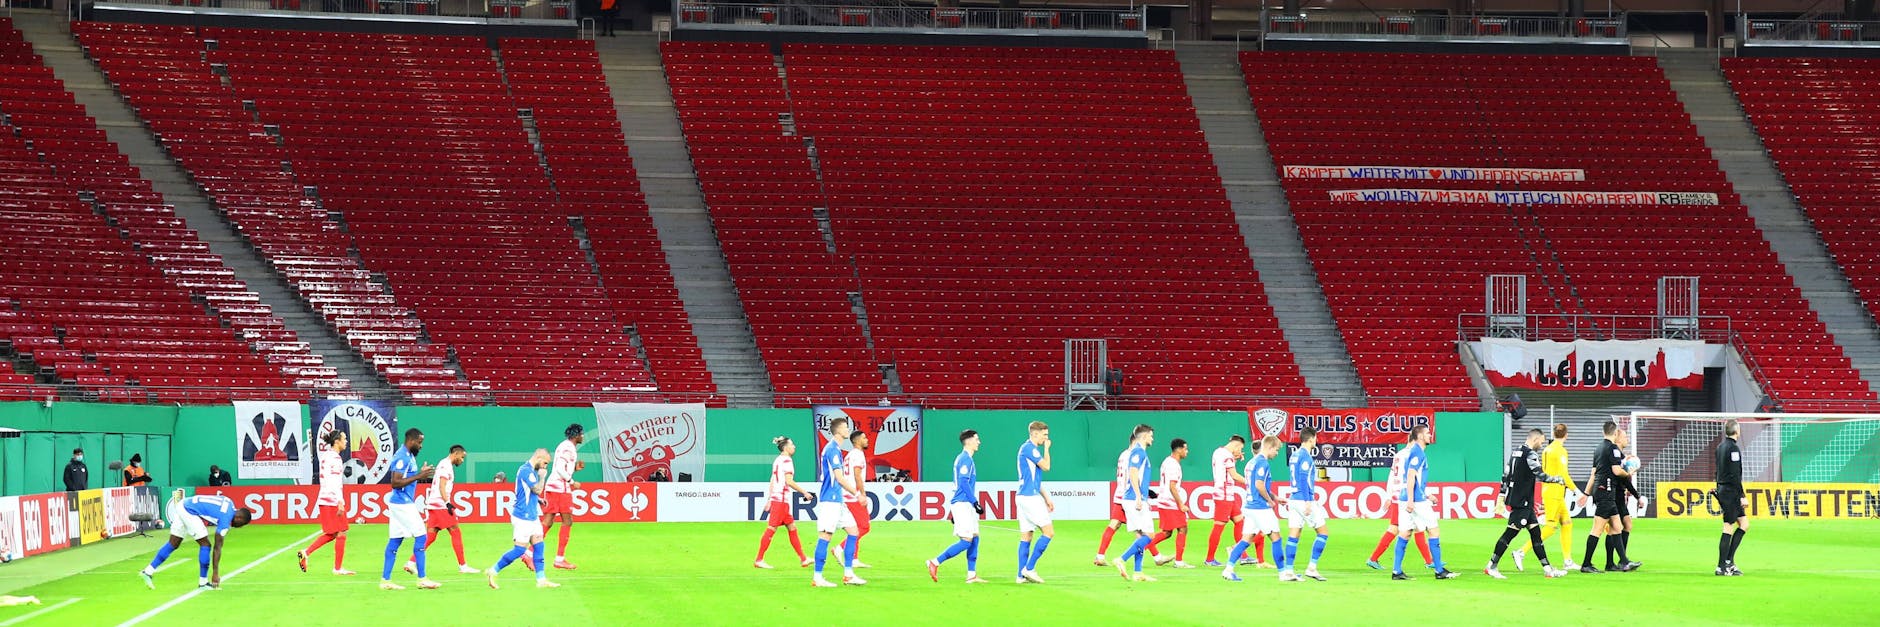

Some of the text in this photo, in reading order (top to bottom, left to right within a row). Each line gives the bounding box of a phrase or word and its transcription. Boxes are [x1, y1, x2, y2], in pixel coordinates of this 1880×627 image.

[1286, 167, 1577, 182] KÄMPFT WEITER MIT UND LEIDENSCHAFT
[1331, 191, 1359, 202] WIR
[1361, 190, 1419, 203] WOLLEN
[1420, 190, 1450, 203] ZUM
[1464, 191, 1489, 203] MAL
[1495, 192, 1519, 204] MIT
[1523, 192, 1561, 205] EUCH
[1564, 193, 1604, 205] NACH
[1606, 193, 1656, 205] BERLIN
[1658, 193, 1680, 205] RB
[1537, 358, 1648, 387] L.E. BULLS
[318, 420, 334, 452] RED
[346, 405, 391, 453] CAMPUS
[867, 416, 920, 433] Bulls
[1293, 415, 1430, 433] BULLS CLUB
[1331, 459, 1351, 467] FROM
[452, 490, 611, 517] STRSS
[1424, 485, 1508, 519] ERG
[1666, 487, 1880, 517] SPOTWETTEN
